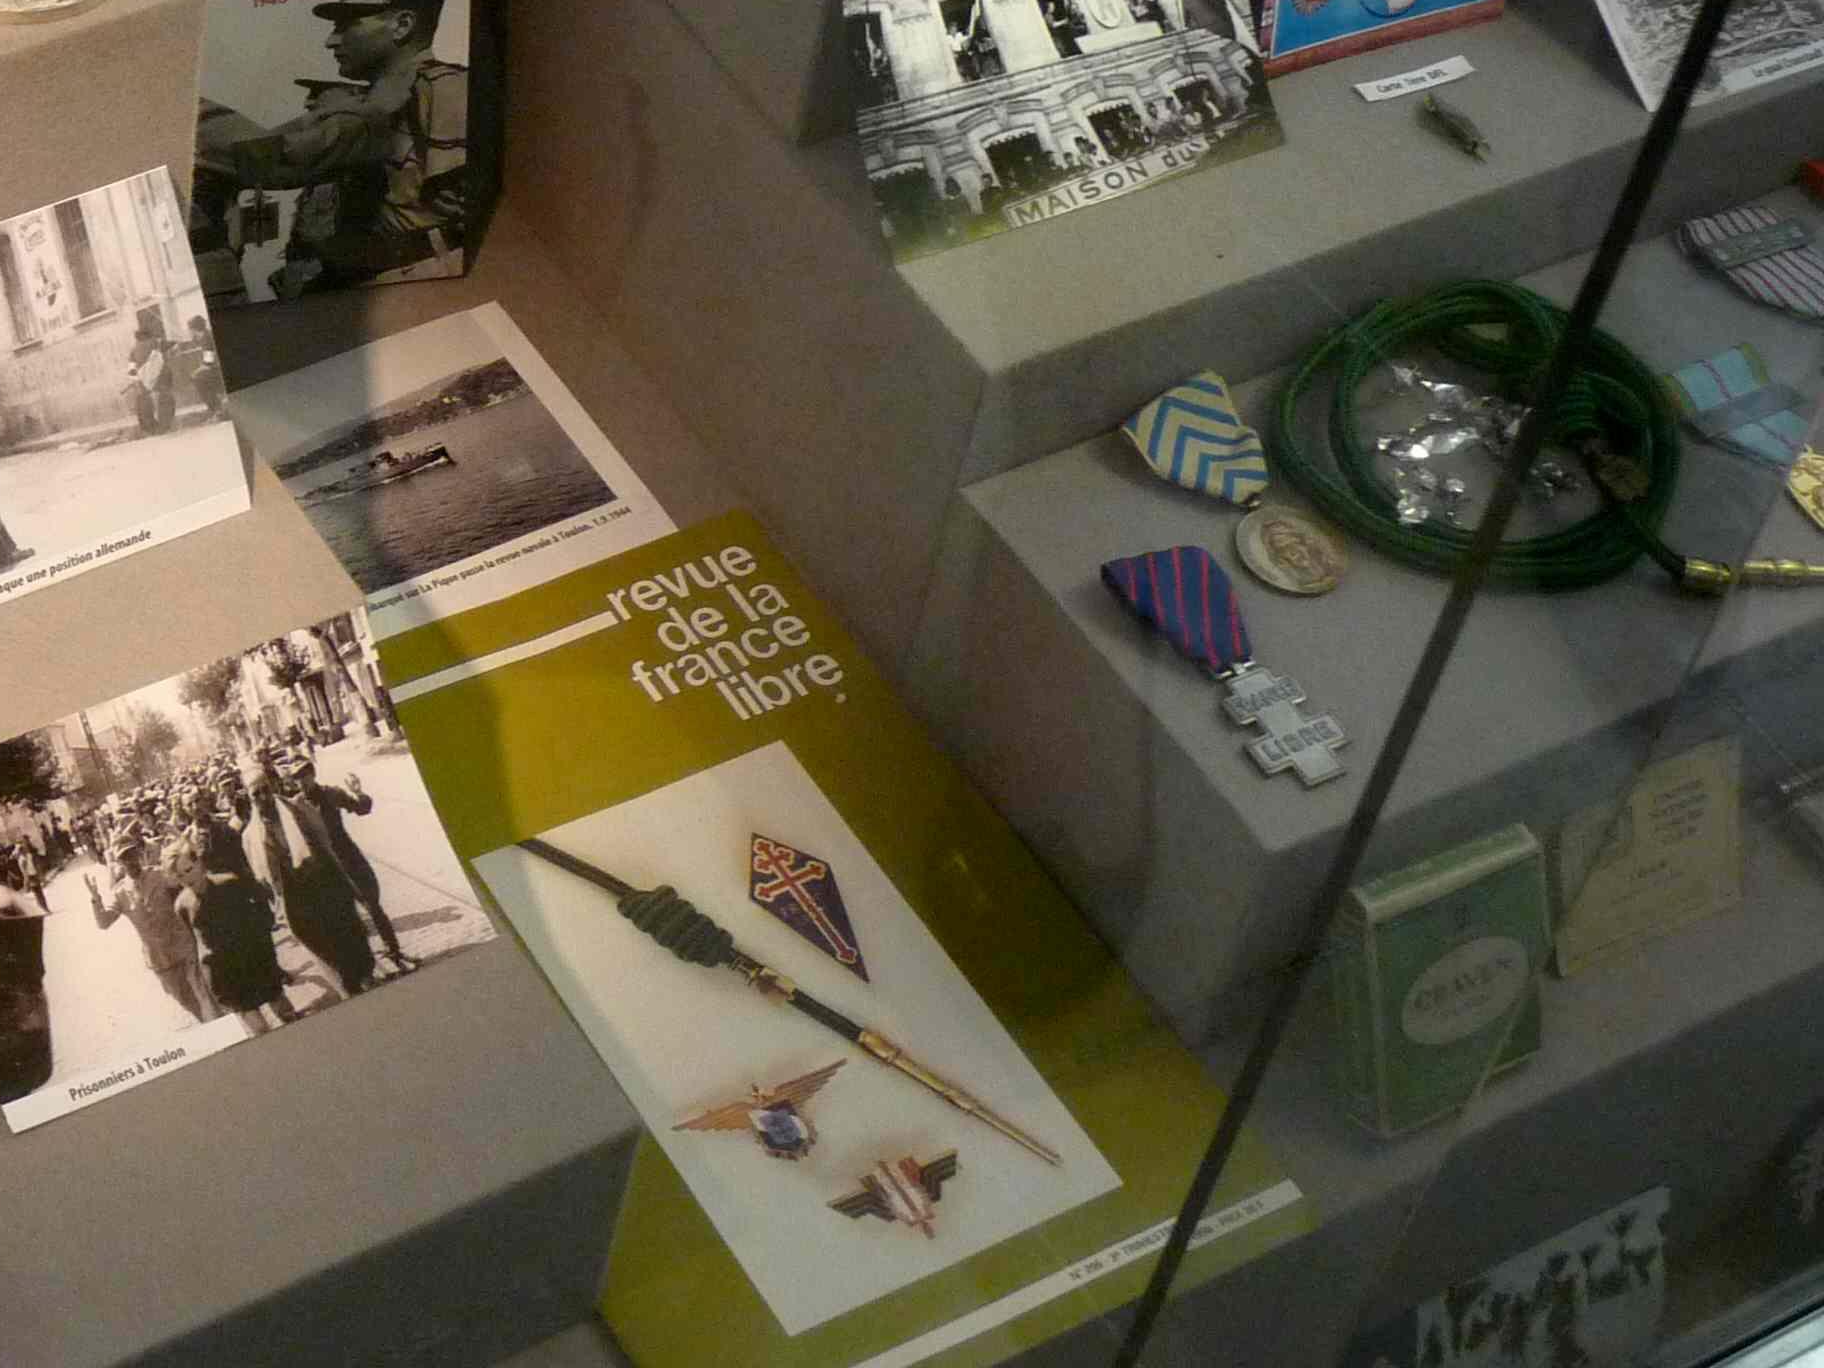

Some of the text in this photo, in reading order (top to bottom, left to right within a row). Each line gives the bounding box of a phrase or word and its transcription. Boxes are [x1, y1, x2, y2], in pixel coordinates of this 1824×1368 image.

[1013, 156, 1150, 229] MAISON
[26, 569, 47, 584] une
[49, 551, 94, 579] position
[95, 529, 152, 560] allemande
[605, 544, 757, 622] revue
[656, 582, 791, 653] de la
[631, 614, 811, 703] france
[716, 651, 844, 721] libre
[68, 1045, 187, 1102] Prisonniers à Toulon
